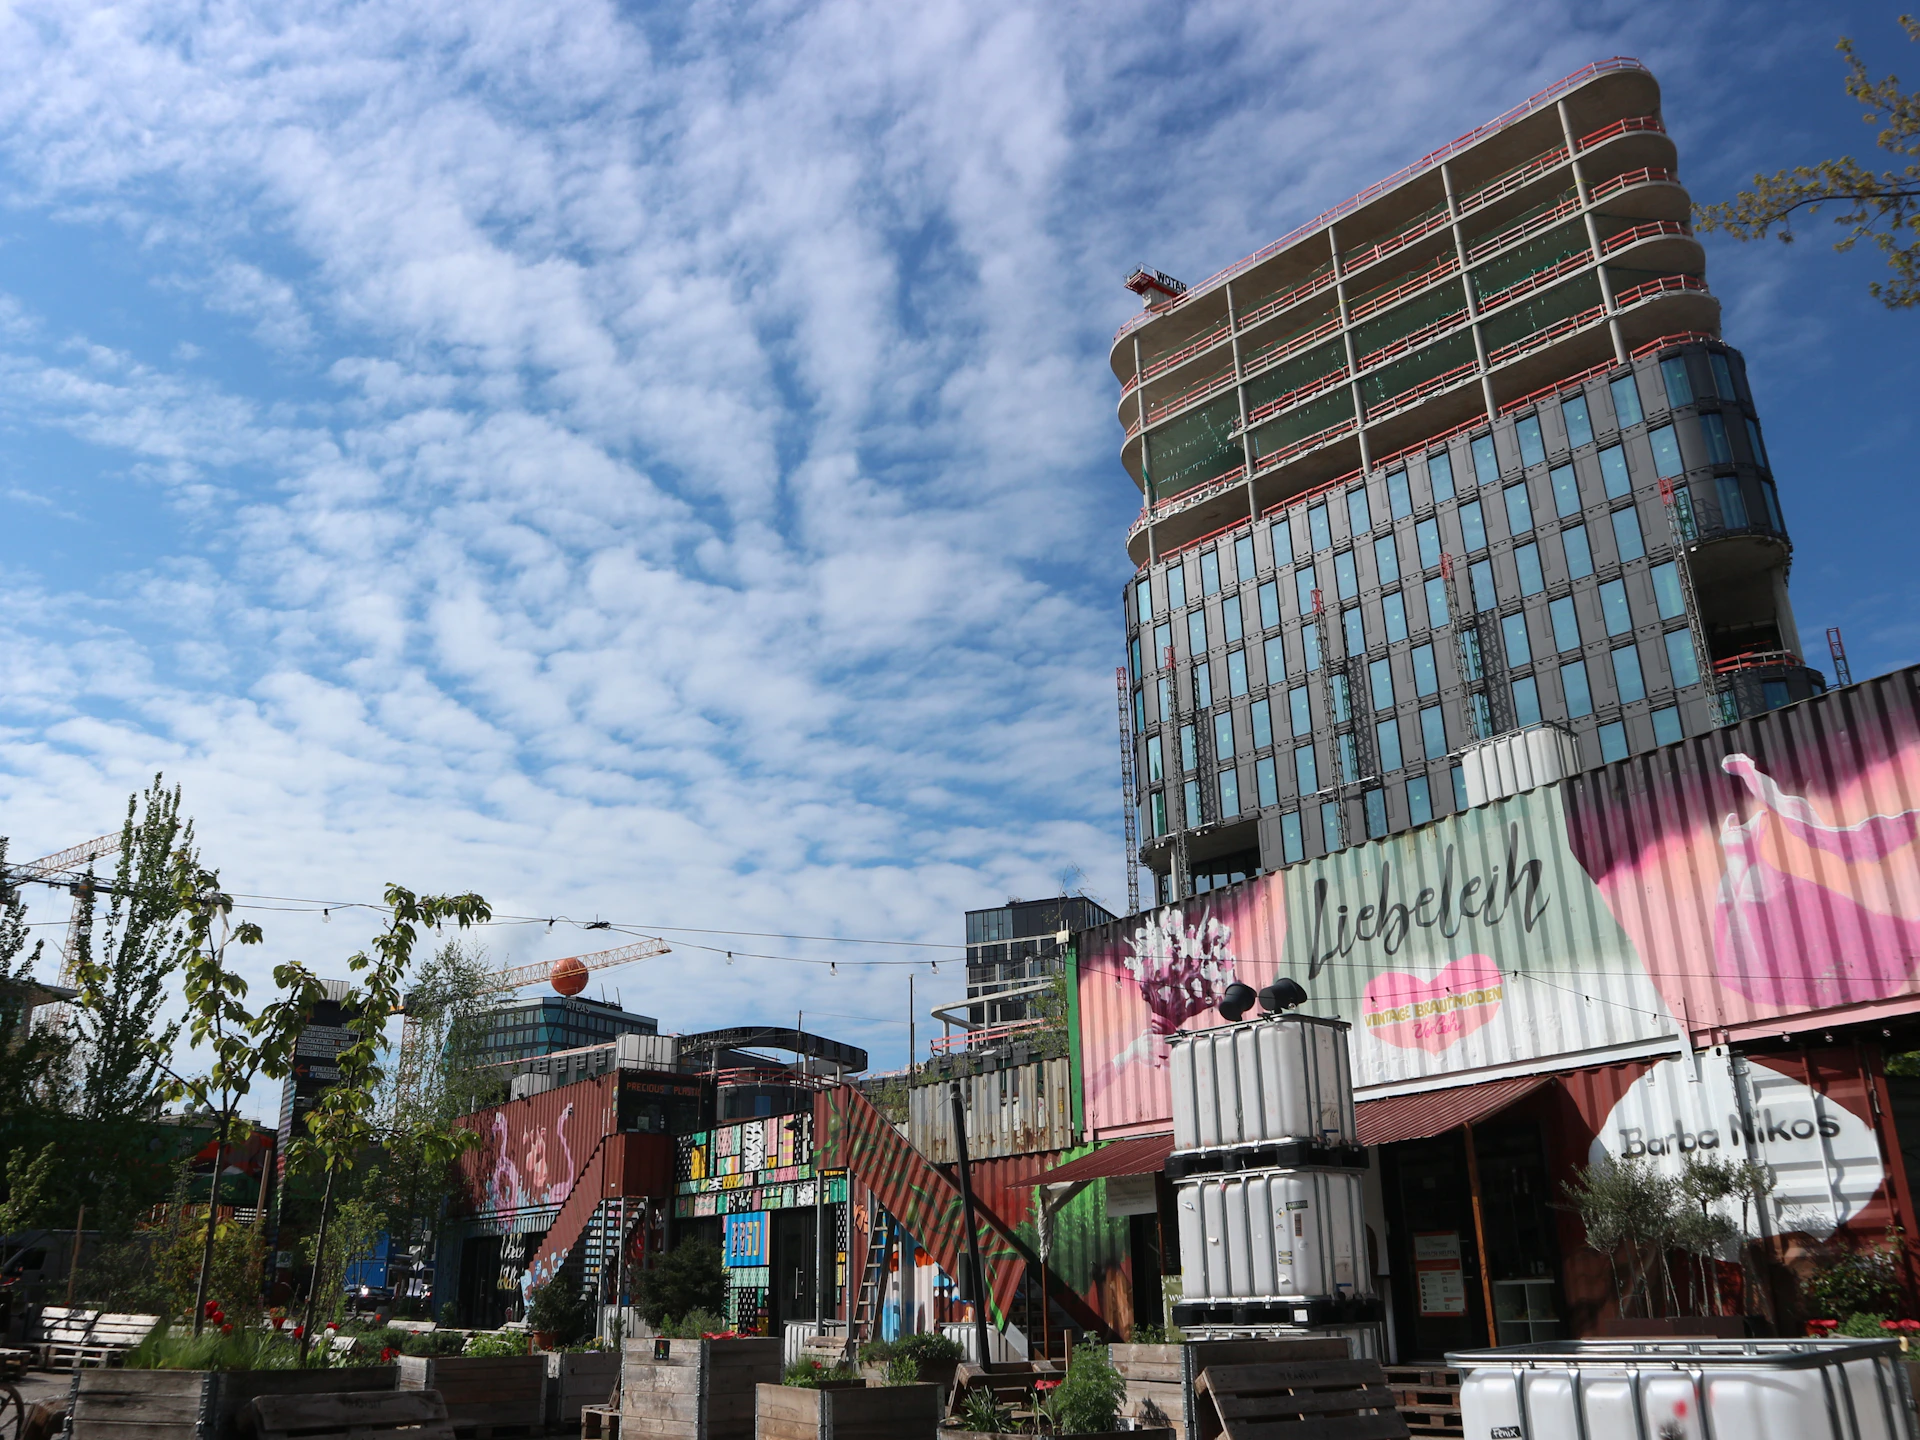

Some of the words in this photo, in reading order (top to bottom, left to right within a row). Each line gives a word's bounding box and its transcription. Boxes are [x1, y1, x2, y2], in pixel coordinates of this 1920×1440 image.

[566, 1001, 590, 1014] ATLAS
[1364, 1006, 1411, 1027] VINTAGE
[1412, 1011, 1464, 1039] Verleih
[626, 1082, 665, 1093] PRECIOUS
[1619, 1120, 1719, 1159] Barba
[1728, 1108, 1841, 1146] Nikos
